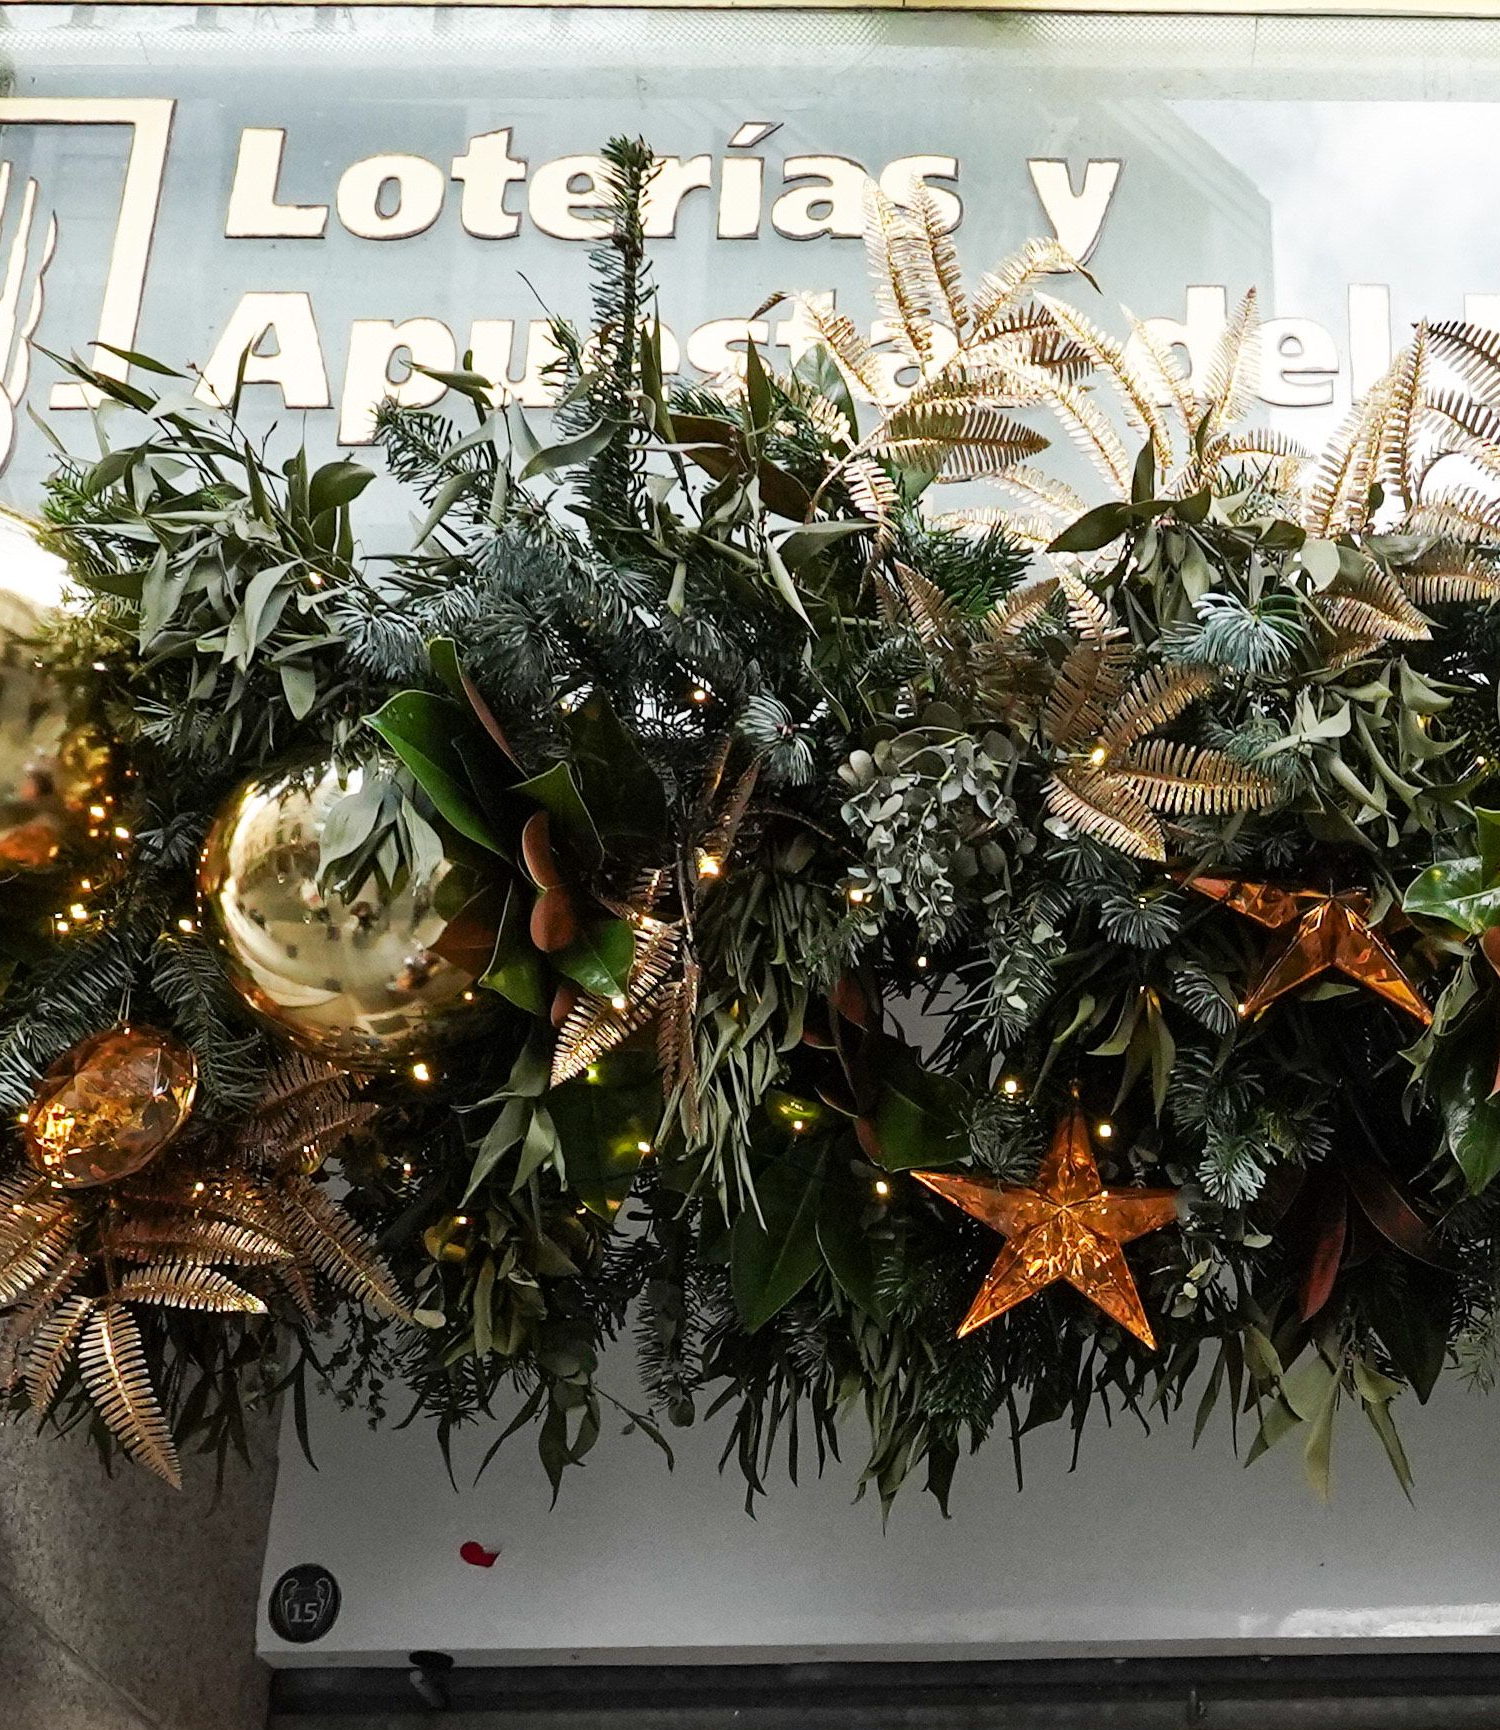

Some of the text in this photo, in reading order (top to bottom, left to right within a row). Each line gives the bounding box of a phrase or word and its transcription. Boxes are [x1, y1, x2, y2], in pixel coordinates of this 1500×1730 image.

[223, 120, 1127, 275] Loterías y
[1122, 283, 1393, 408] del
[290, 1602, 318, 1623] 15
